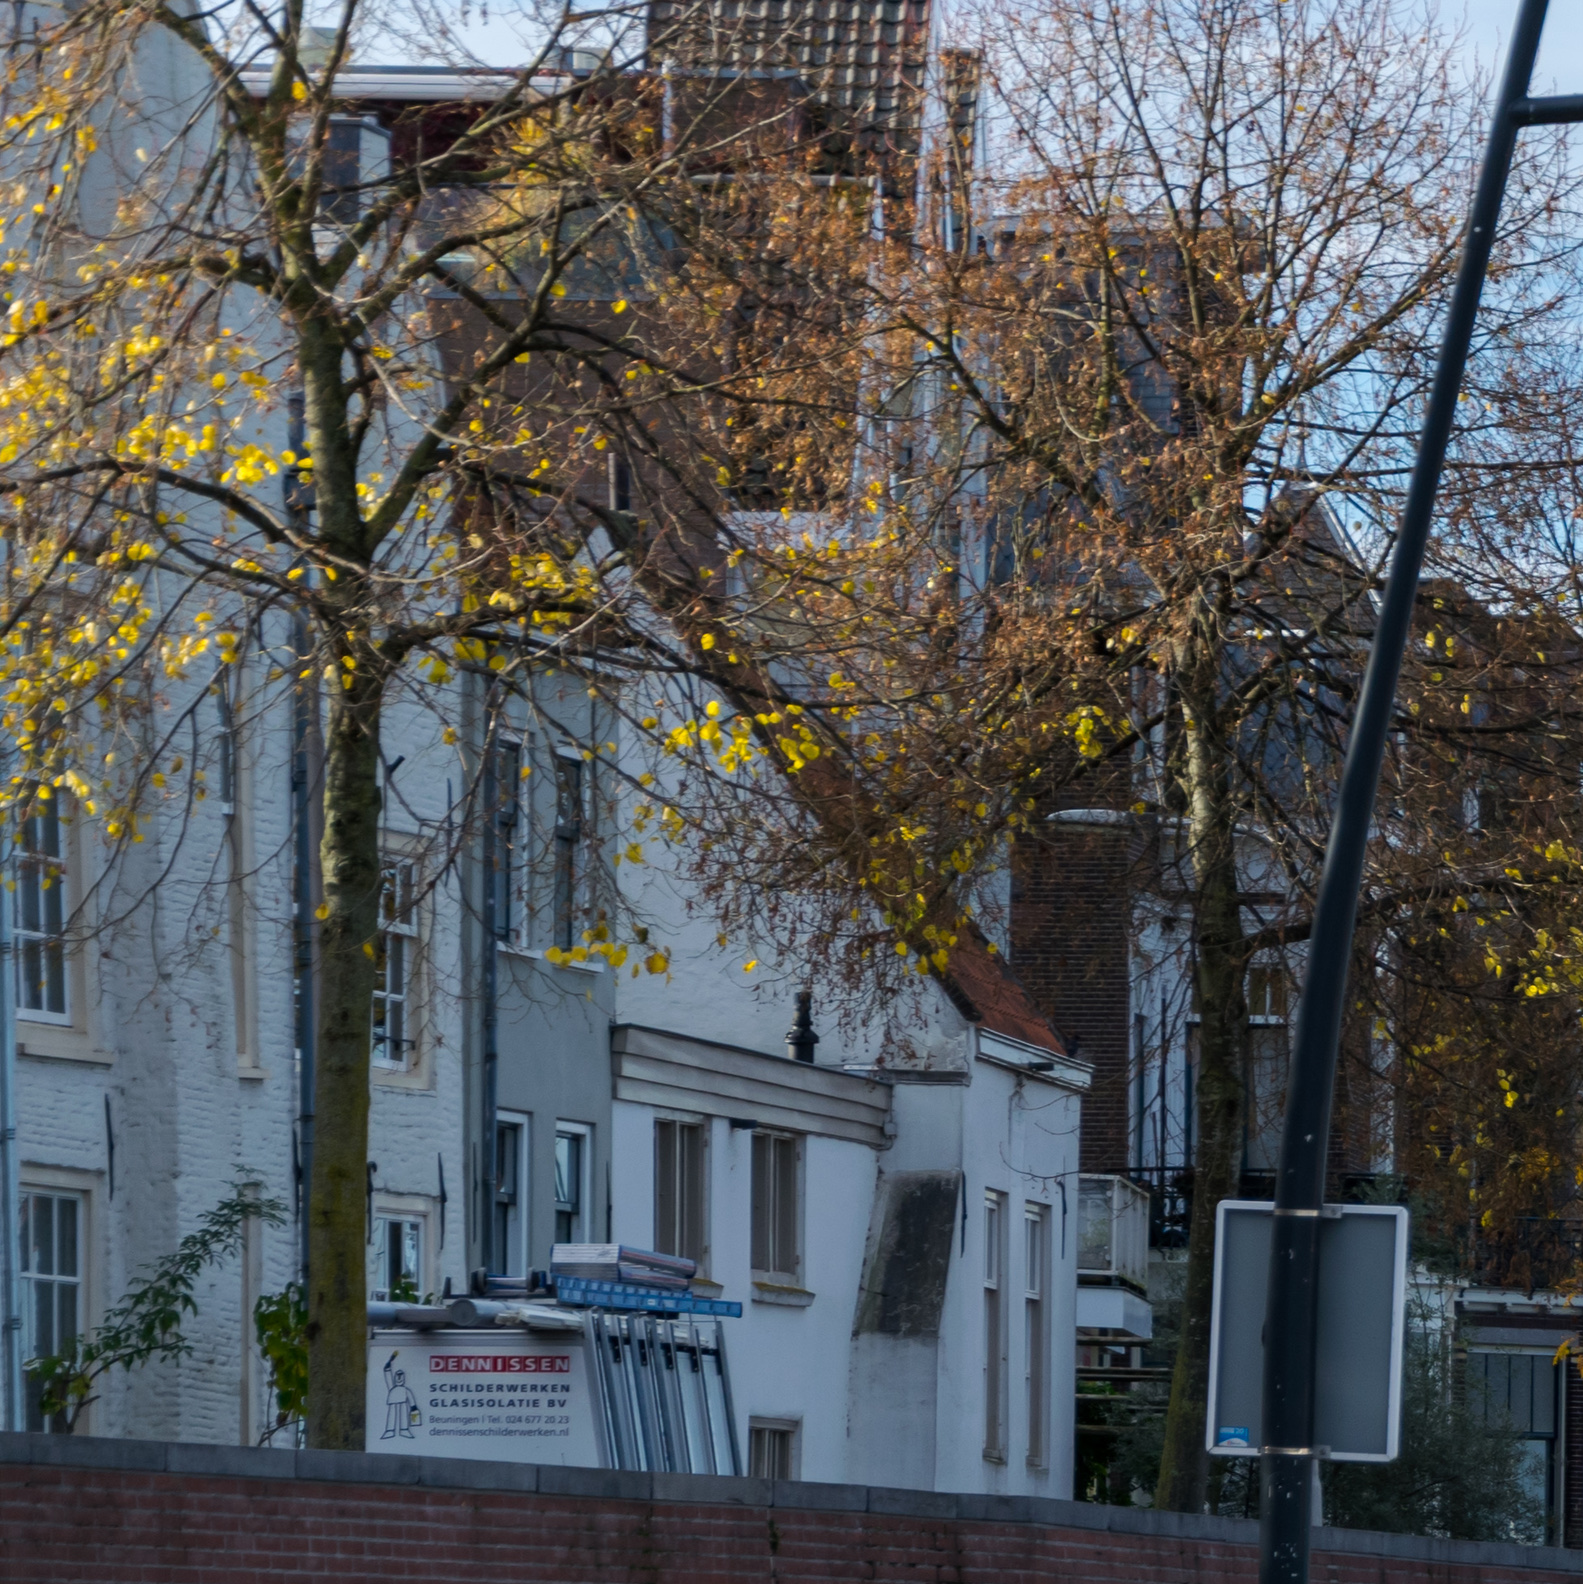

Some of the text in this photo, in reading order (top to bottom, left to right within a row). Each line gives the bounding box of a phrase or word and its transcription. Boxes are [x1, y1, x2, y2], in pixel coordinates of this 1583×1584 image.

[430, 1357, 569, 1371] DENNISSEN
[429, 1383, 570, 1393] SCHILDERWERKEN
[429, 1398, 567, 1408] GLASISOLATIE BV
[429, 1415, 479, 1425] Beuningen
[487, 1415, 503, 1424] Tel.
[505, 1415, 522, 1424] 024
[525, 1415, 541, 1424] 677
[545, 1415, 555, 1424] 20
[558, 1415, 569, 1424] 23
[429, 1427, 569, 1436] dennissenschilderwerken.nl
